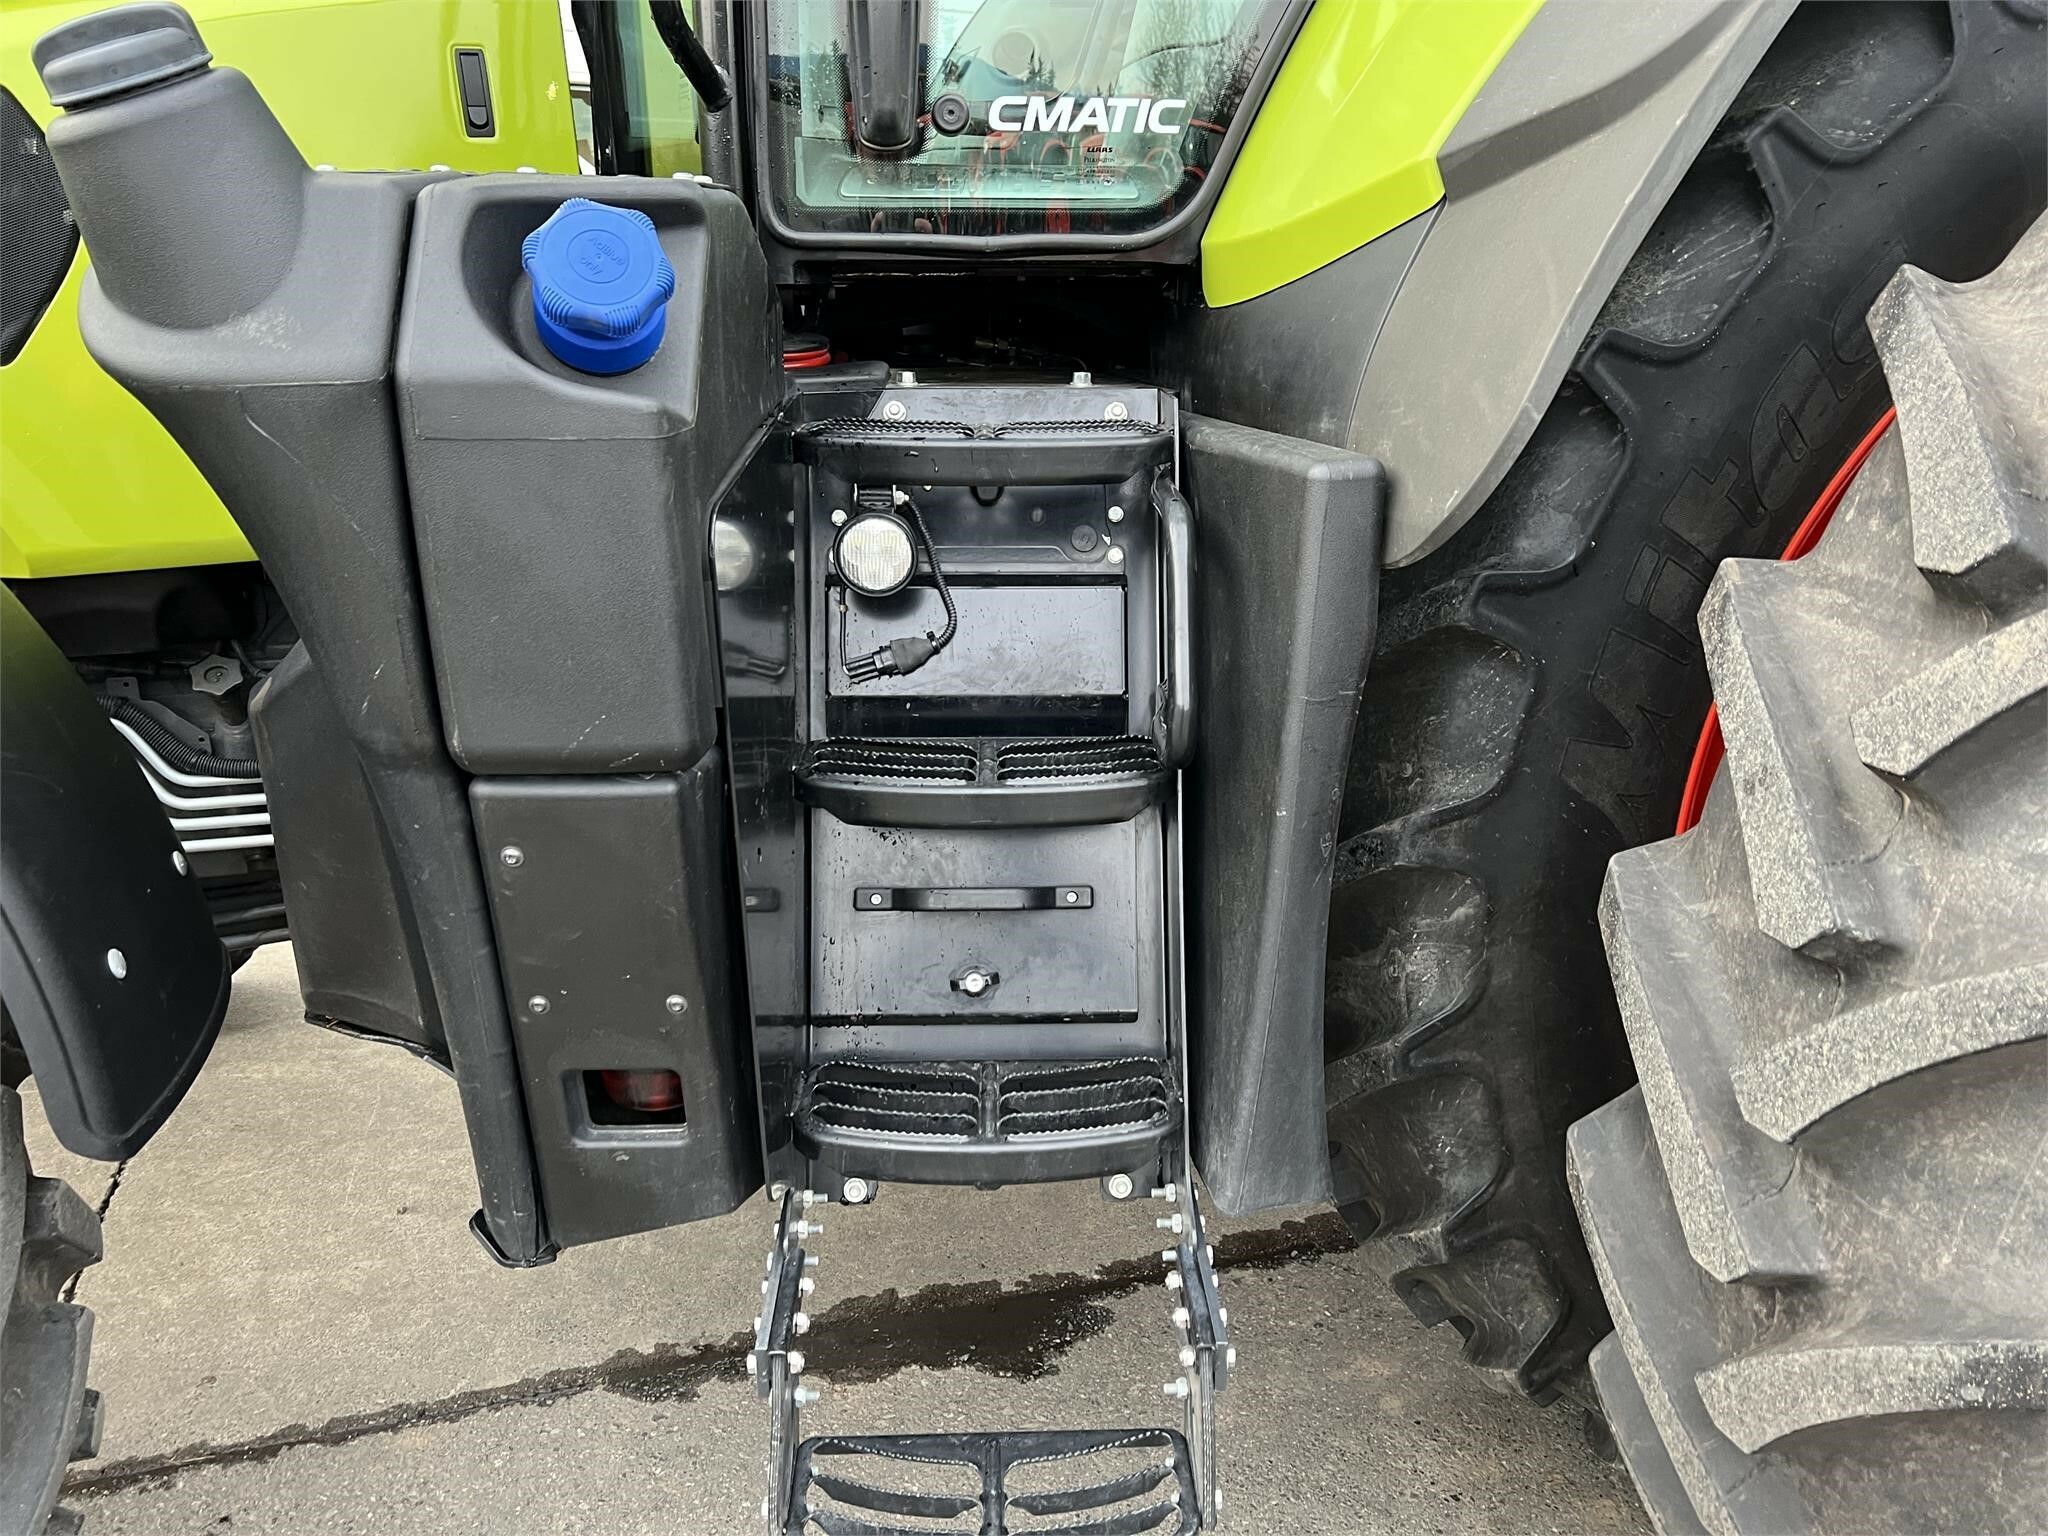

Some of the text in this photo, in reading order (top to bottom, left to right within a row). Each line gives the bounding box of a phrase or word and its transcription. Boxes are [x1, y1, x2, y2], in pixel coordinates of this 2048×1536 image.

[988, 95, 1187, 134] CMATIC
[586, 237, 626, 266] AdBlue
[580, 257, 603, 276] only
